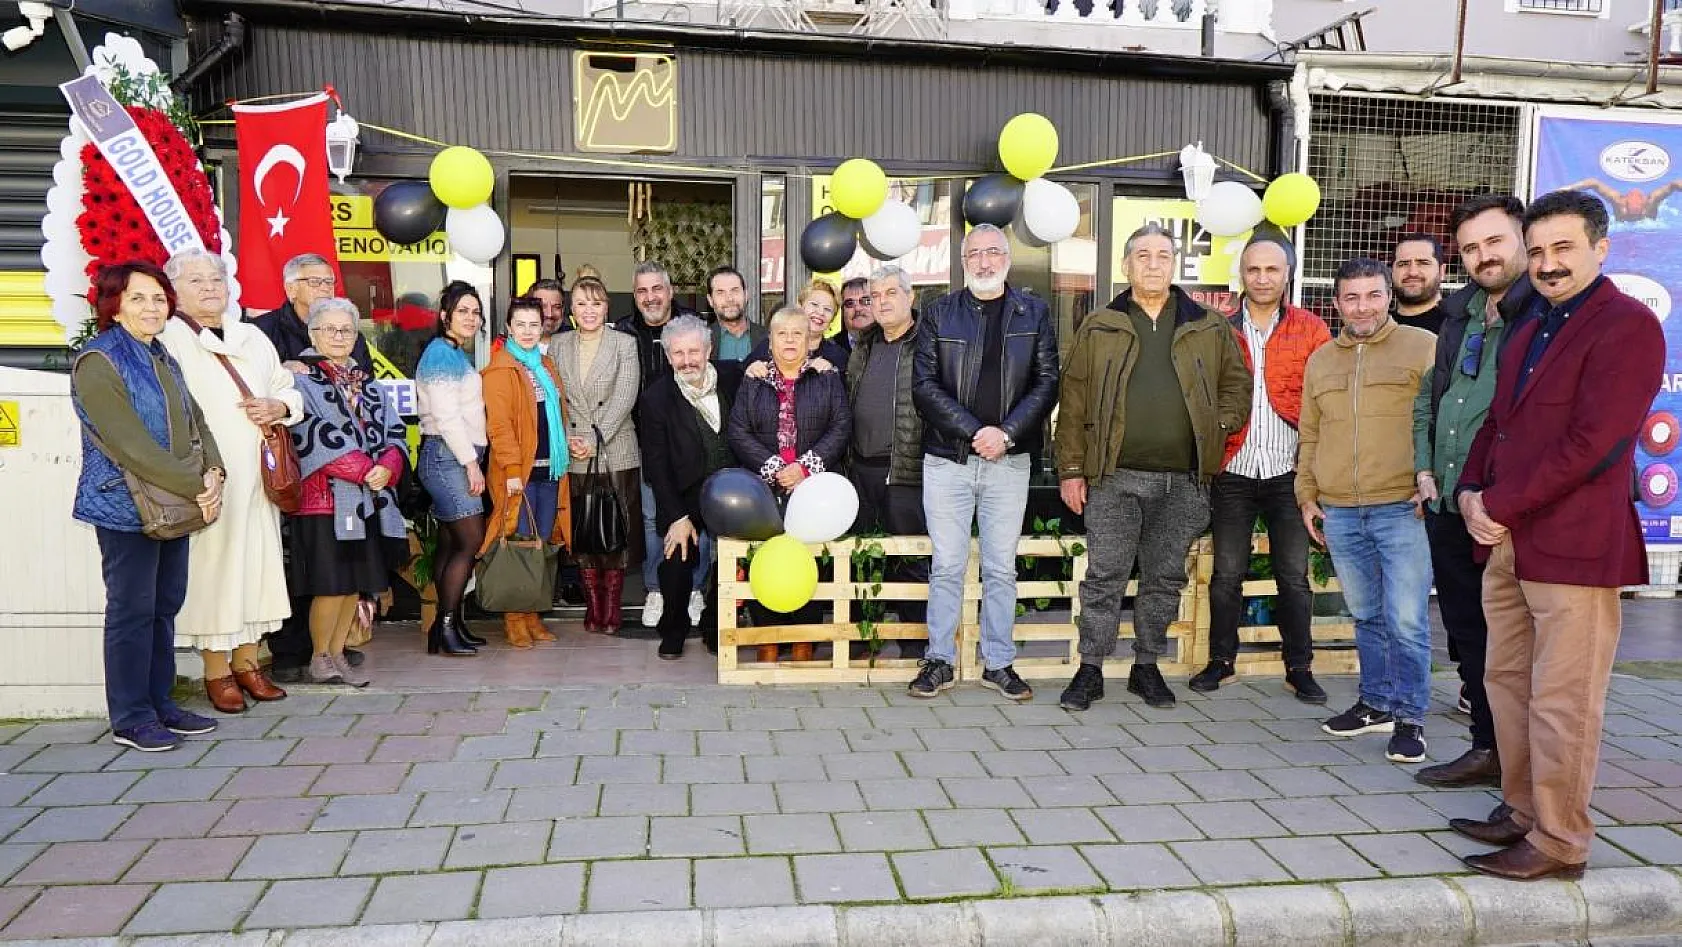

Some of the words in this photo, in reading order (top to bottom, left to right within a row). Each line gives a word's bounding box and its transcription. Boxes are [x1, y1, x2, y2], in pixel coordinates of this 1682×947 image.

[107, 135, 158, 188] GOLD
[141, 184, 193, 250] HOUSE
[330, 202, 352, 221] S
[334, 236, 453, 255] ENOVATIO
